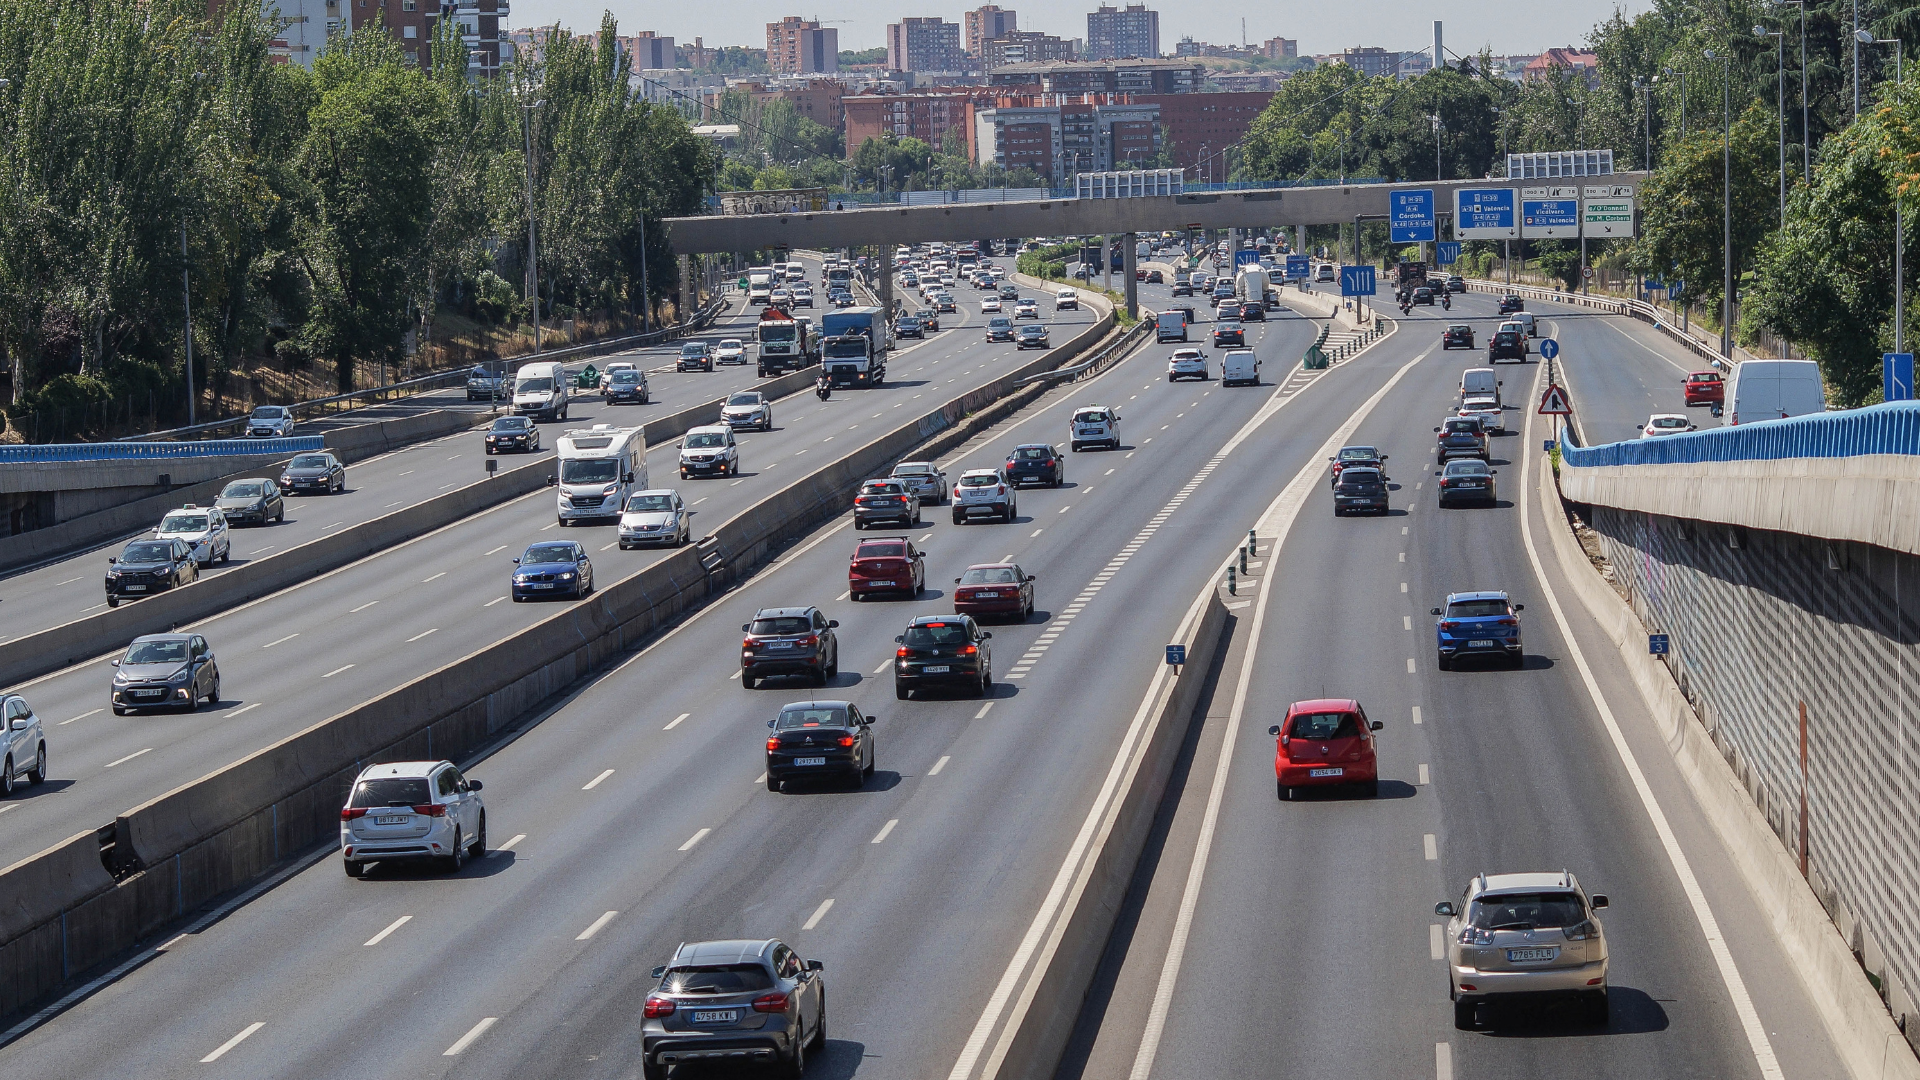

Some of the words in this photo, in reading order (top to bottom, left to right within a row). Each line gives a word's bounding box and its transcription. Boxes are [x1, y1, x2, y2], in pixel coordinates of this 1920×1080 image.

[1655, 643, 1663, 652] 3
[1172, 653, 1179, 662] 3
[1513, 949, 1534, 959] 7785
[1535, 949, 1552, 958] FLR
[695, 1011, 717, 1021] 4758
